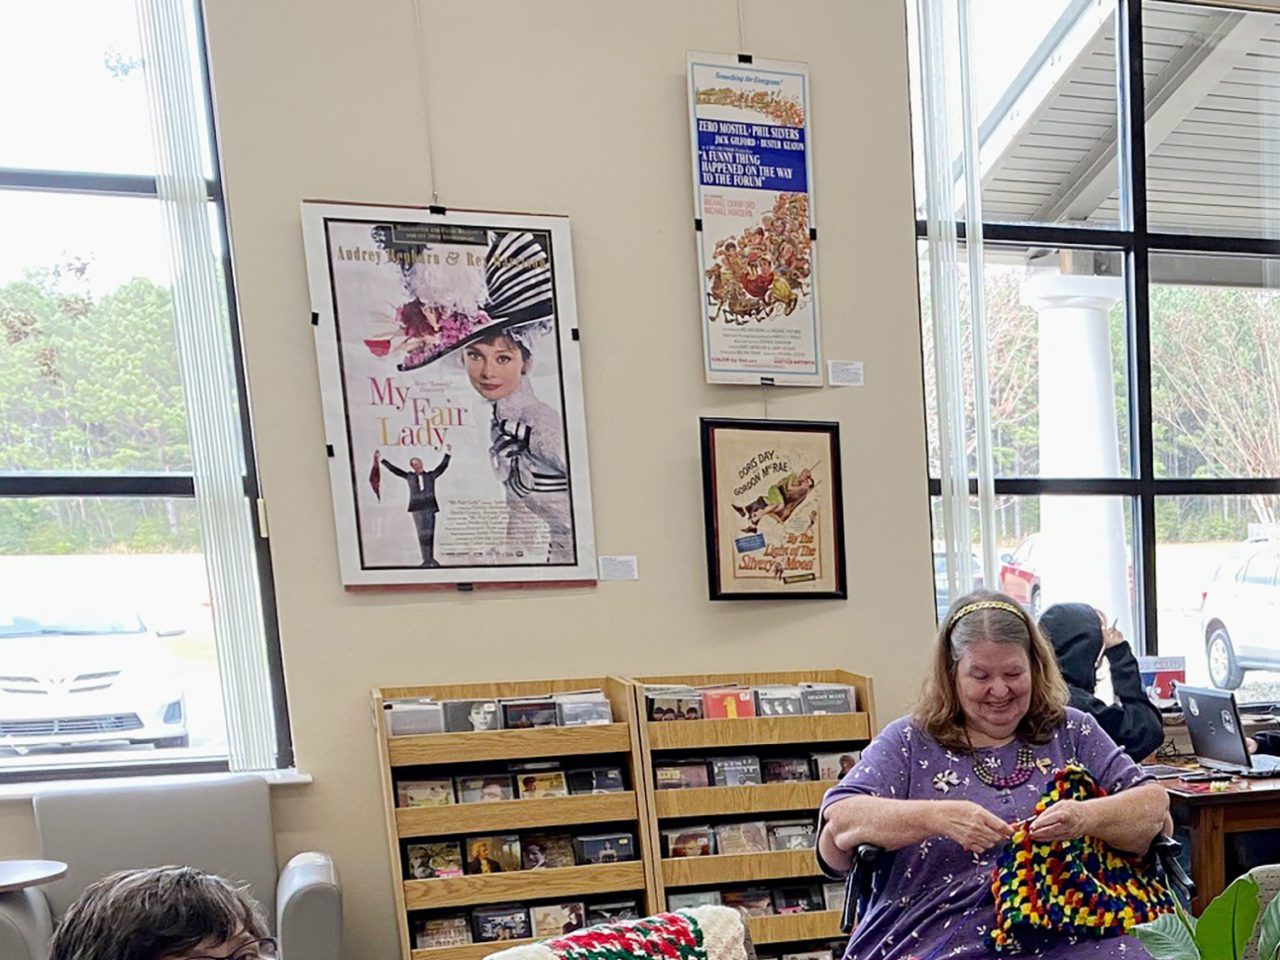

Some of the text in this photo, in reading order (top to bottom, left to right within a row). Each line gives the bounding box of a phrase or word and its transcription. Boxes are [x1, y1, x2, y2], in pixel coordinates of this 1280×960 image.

[699, 120, 800, 140] ZERO MOSTEL PHIL SILVERS
[715, 135, 729, 145] JACK
[730, 136, 756, 147] GILFORD
[709, 151, 734, 164] FUNNY
[736, 154, 761, 166] THING
[701, 161, 793, 180] HAPPENED ON THE WAY
[702, 172, 713, 183] TO
[715, 173, 732, 185] THE
[337, 245, 382, 266] Audrey
[446, 251, 461, 266] &
[367, 376, 411, 412] My
[410, 396, 469, 426] Fair
[376, 416, 448, 453] Lady
[738, 449, 775, 479] DORIS DAY
[733, 473, 762, 497] GORDON
[763, 543, 789, 559] Light
[789, 545, 800, 557] of
[799, 544, 816, 557] The
[738, 554, 775, 573] Silvery
